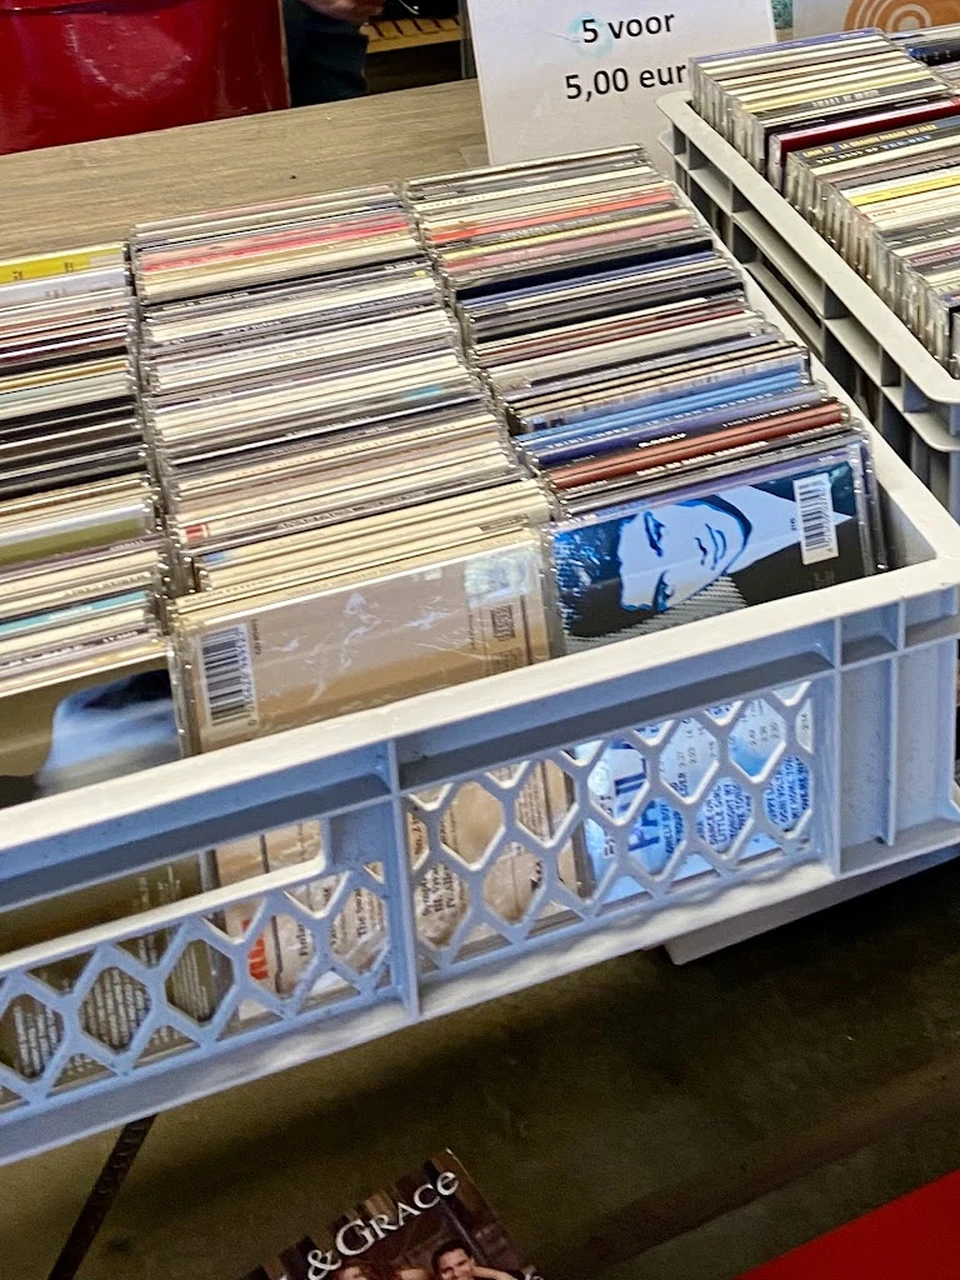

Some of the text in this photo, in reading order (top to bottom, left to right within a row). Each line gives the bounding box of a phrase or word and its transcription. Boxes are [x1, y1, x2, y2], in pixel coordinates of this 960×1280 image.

[581, 13, 676, 44] 5 voor
[564, 66, 630, 103] 5,00
[306, 1249, 343, 1280] &
